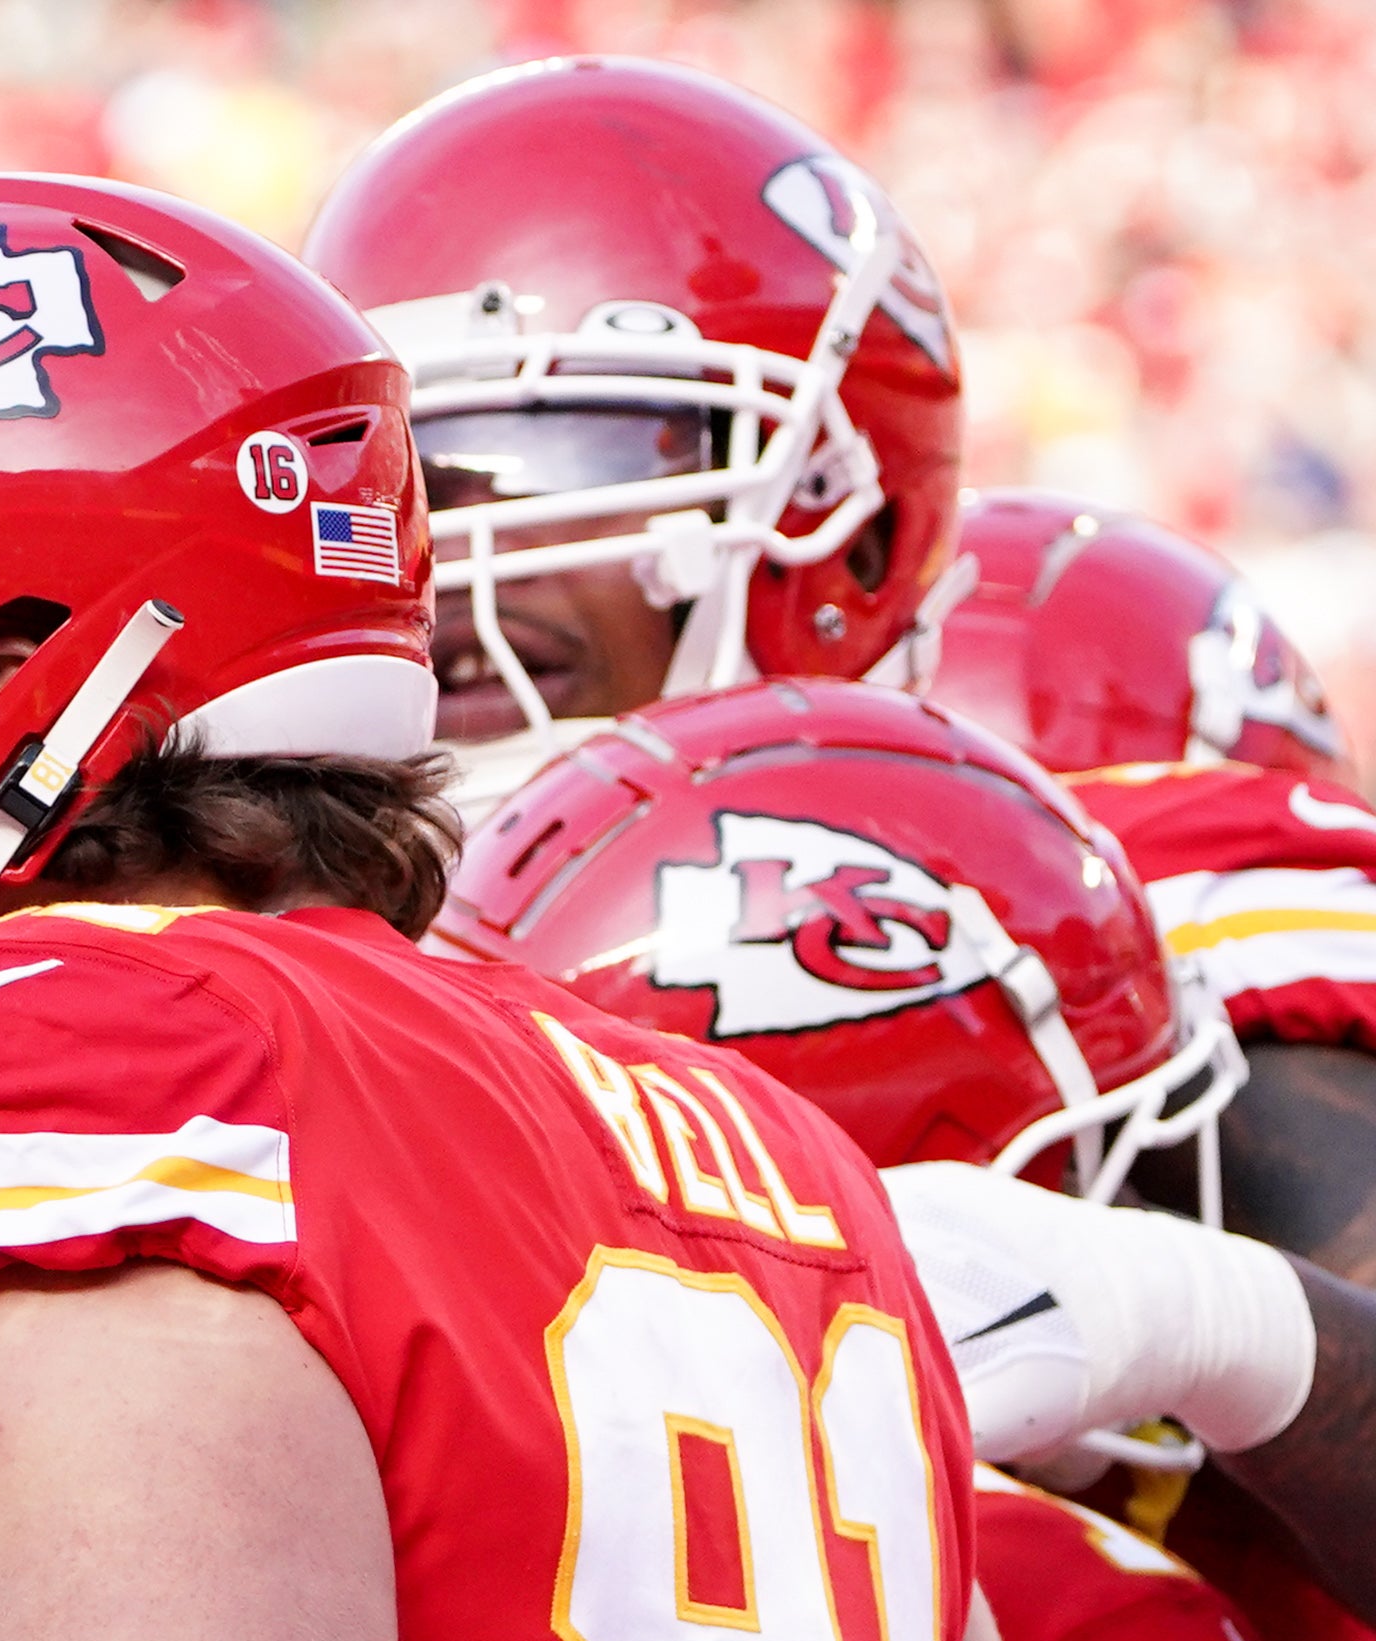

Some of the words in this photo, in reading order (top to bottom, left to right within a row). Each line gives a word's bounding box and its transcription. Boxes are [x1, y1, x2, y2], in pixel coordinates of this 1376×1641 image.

[249, 444, 299, 501] 16
[30, 751, 73, 792] 81
[730, 859, 952, 991] KC
[530, 1011, 848, 1250] BELL
